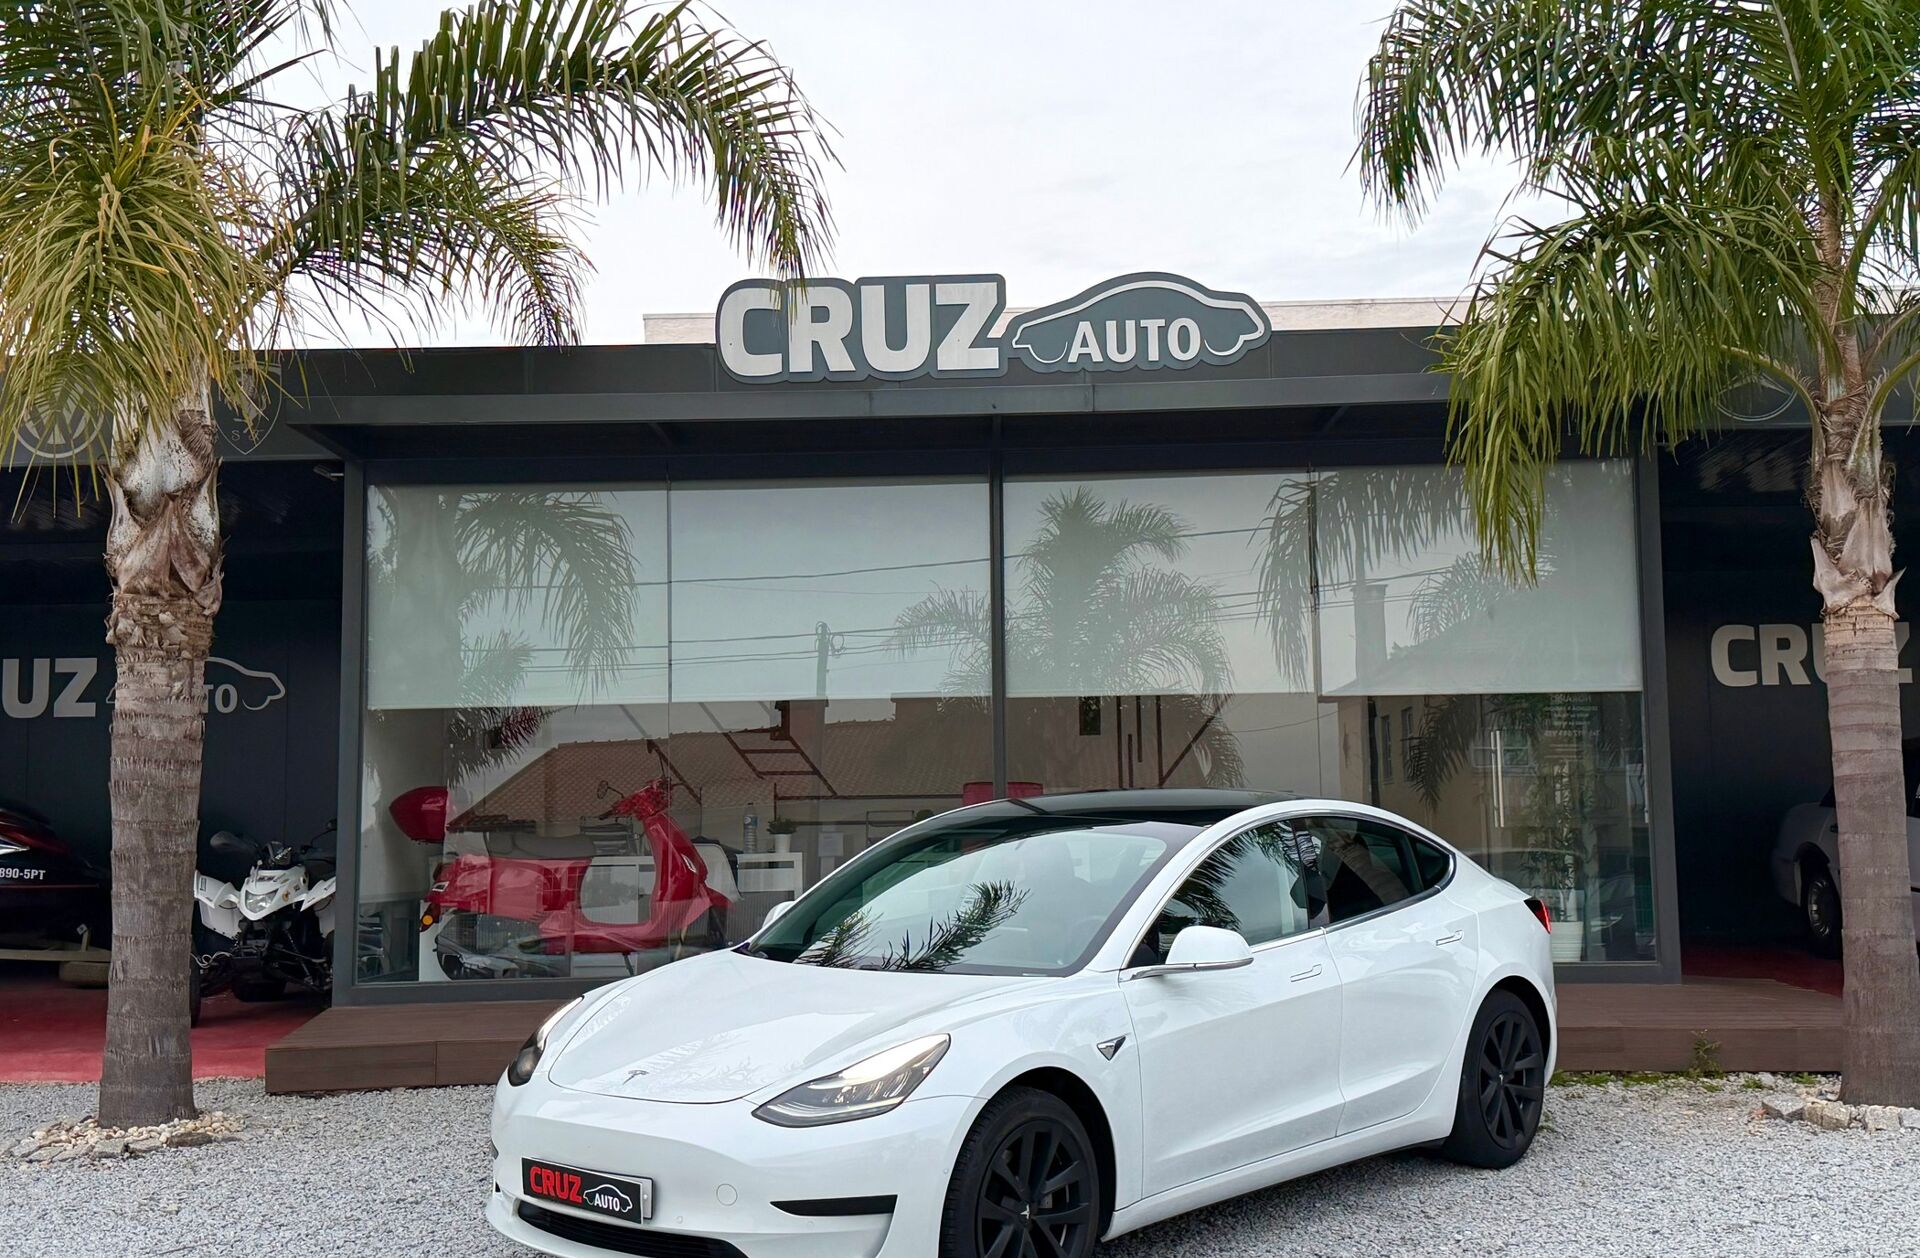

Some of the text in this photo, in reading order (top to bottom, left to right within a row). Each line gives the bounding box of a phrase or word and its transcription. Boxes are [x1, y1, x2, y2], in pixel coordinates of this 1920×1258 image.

[719, 281, 1201, 377] CRUZ AUTO
[1, 657, 238, 718] UZ TO
[529, 1166, 621, 1212] CRUZ AUTO
